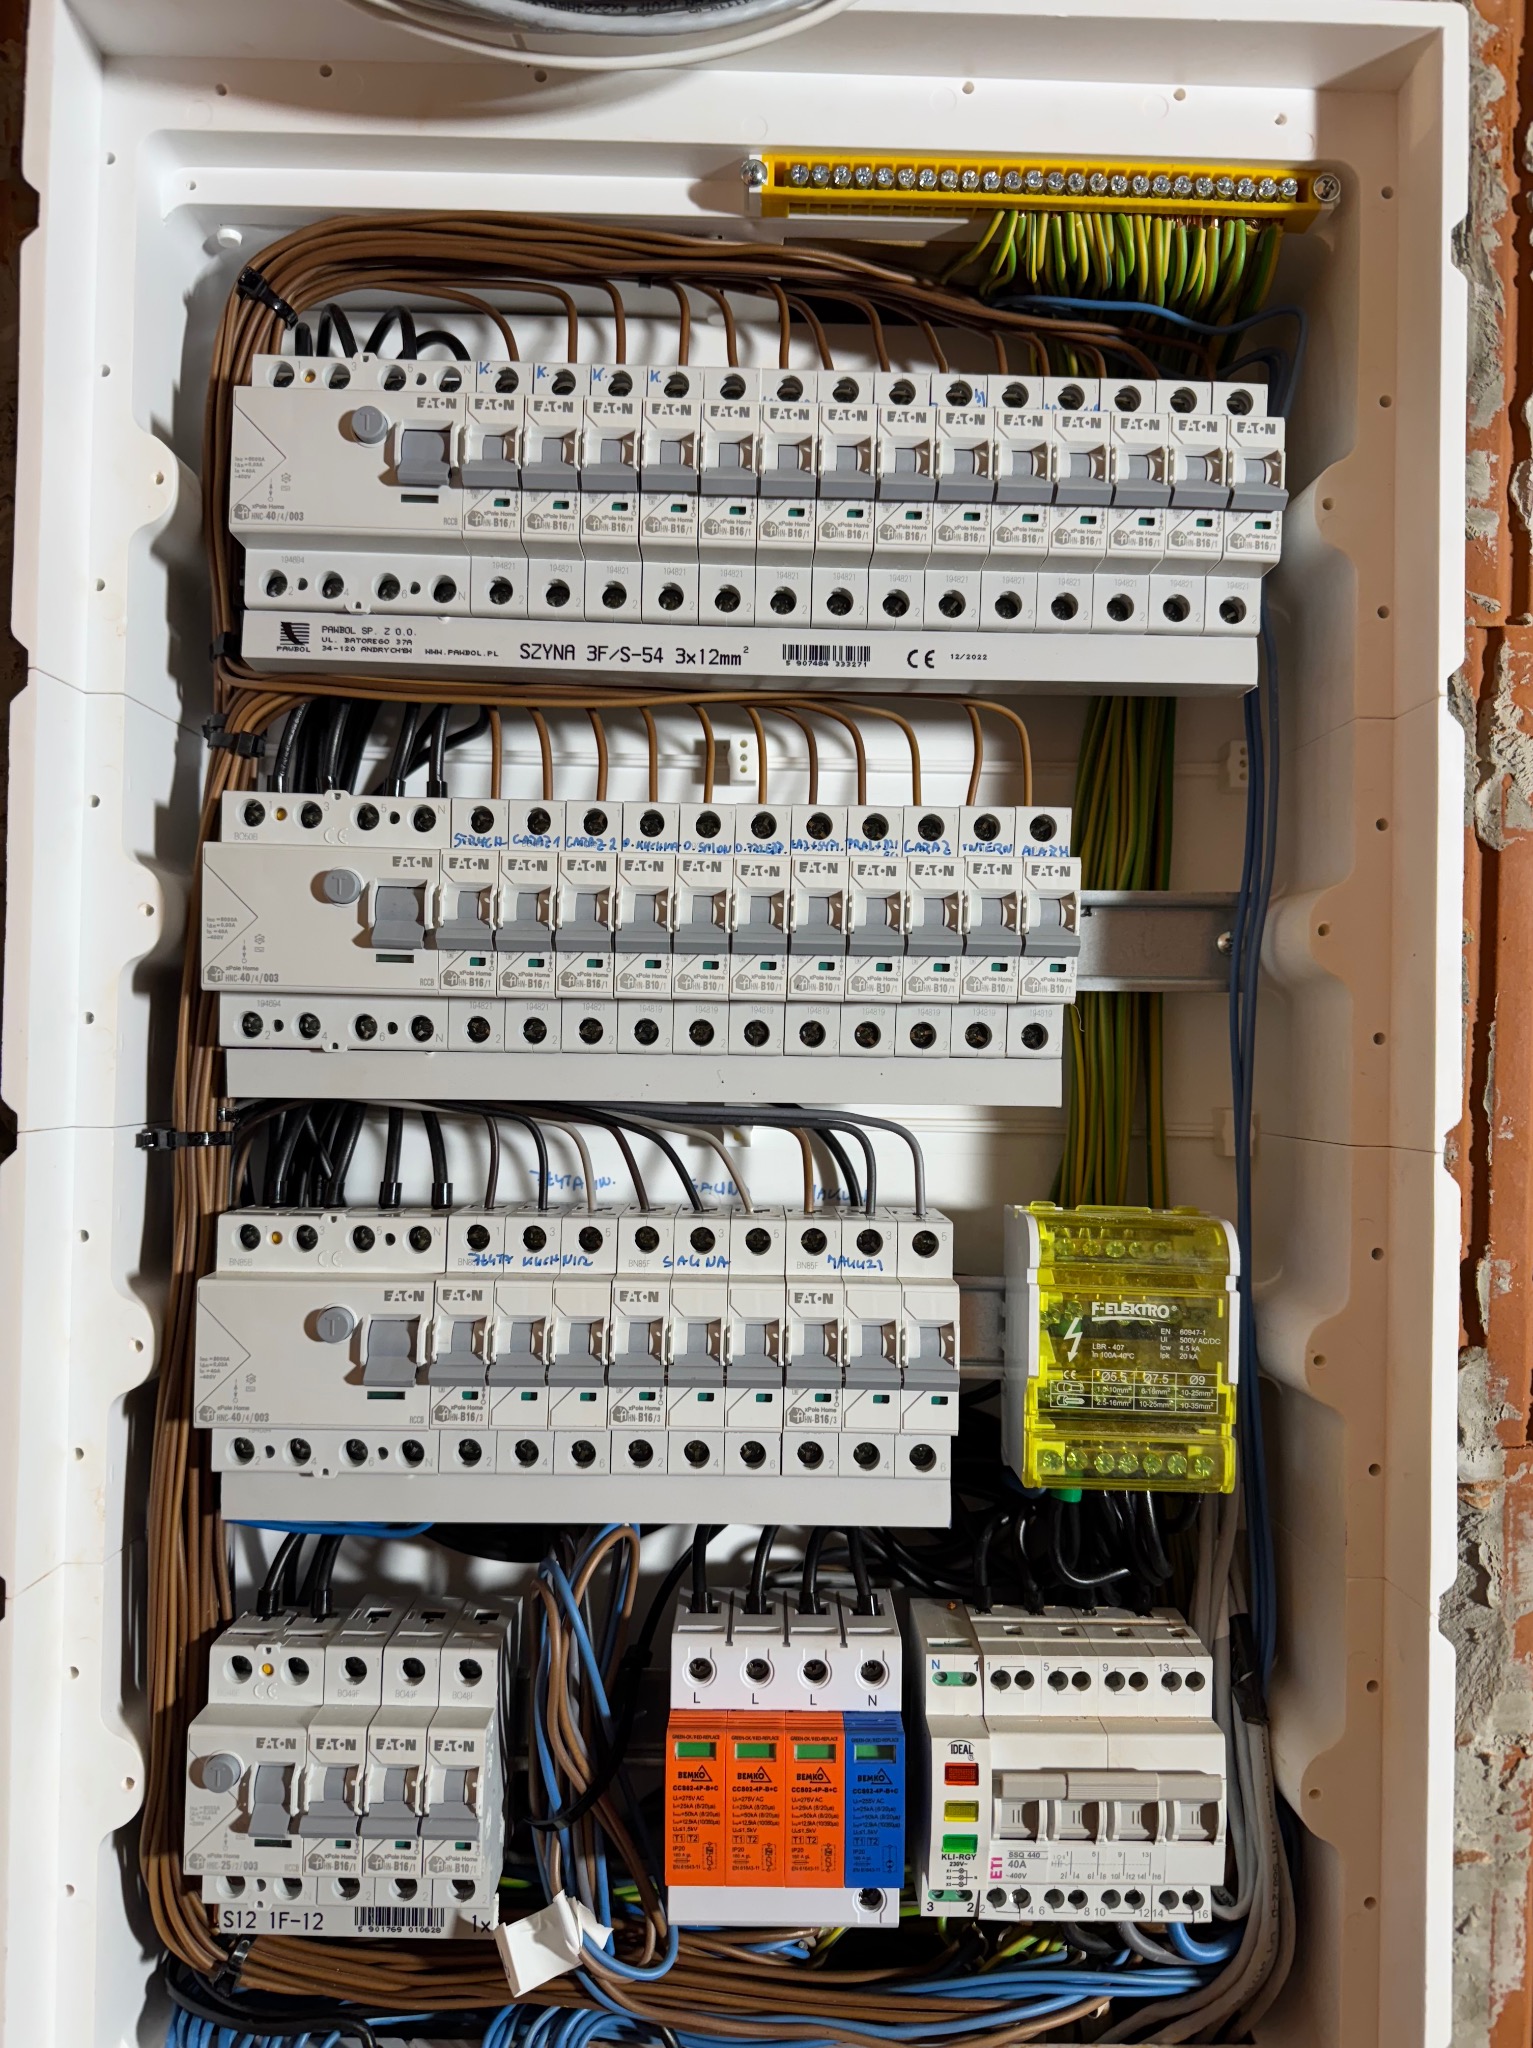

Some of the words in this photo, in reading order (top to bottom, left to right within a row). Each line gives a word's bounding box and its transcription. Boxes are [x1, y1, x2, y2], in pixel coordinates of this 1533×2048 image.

[322, 626, 356, 635] PAWBOL
[362, 627, 377, 636] SP.
[520, 643, 576, 661] SZYNA
[586, 645, 664, 664] 3F/S-54
[907, 649, 936, 669] CE
[1092, 1302, 1170, 1318] F-ELEKTRO
[931, 1659, 940, 1670] N
[1044, 1662, 1050, 1672] 5
[1102, 1663, 1109, 1672] 9
[1158, 1664, 1170, 1672] 13
[693, 1692, 700, 1704] L
[752, 1693, 759, 1705] L
[810, 1694, 817, 1706] L
[868, 1694, 877, 1706] N
[950, 1744, 974, 1754] IDEAL
[678, 1771, 706, 1779] BEMKO
[737, 1772, 764, 1780] BEMKO
[990, 1857, 1003, 1880] ETI
[1008, 1860, 1027, 1868] 40A
[926, 1902, 934, 1912] 3
[967, 1902, 974, 1912] 2
[980, 1906, 986, 1914] 2
[1028, 1906, 1034, 1914] 4
[1038, 1906, 1045, 1915] 6
[1084, 1908, 1090, 1916] 8
[1094, 1908, 1106, 1916] 10
[1138, 1909, 1150, 1918] 12
[1153, 1909, 1164, 1918] 14
[1197, 1910, 1209, 1918] 16
[223, 1910, 257, 1929] S12
[270, 1912, 324, 1930] 1F-12
[408, 1926, 442, 1934] 010628
